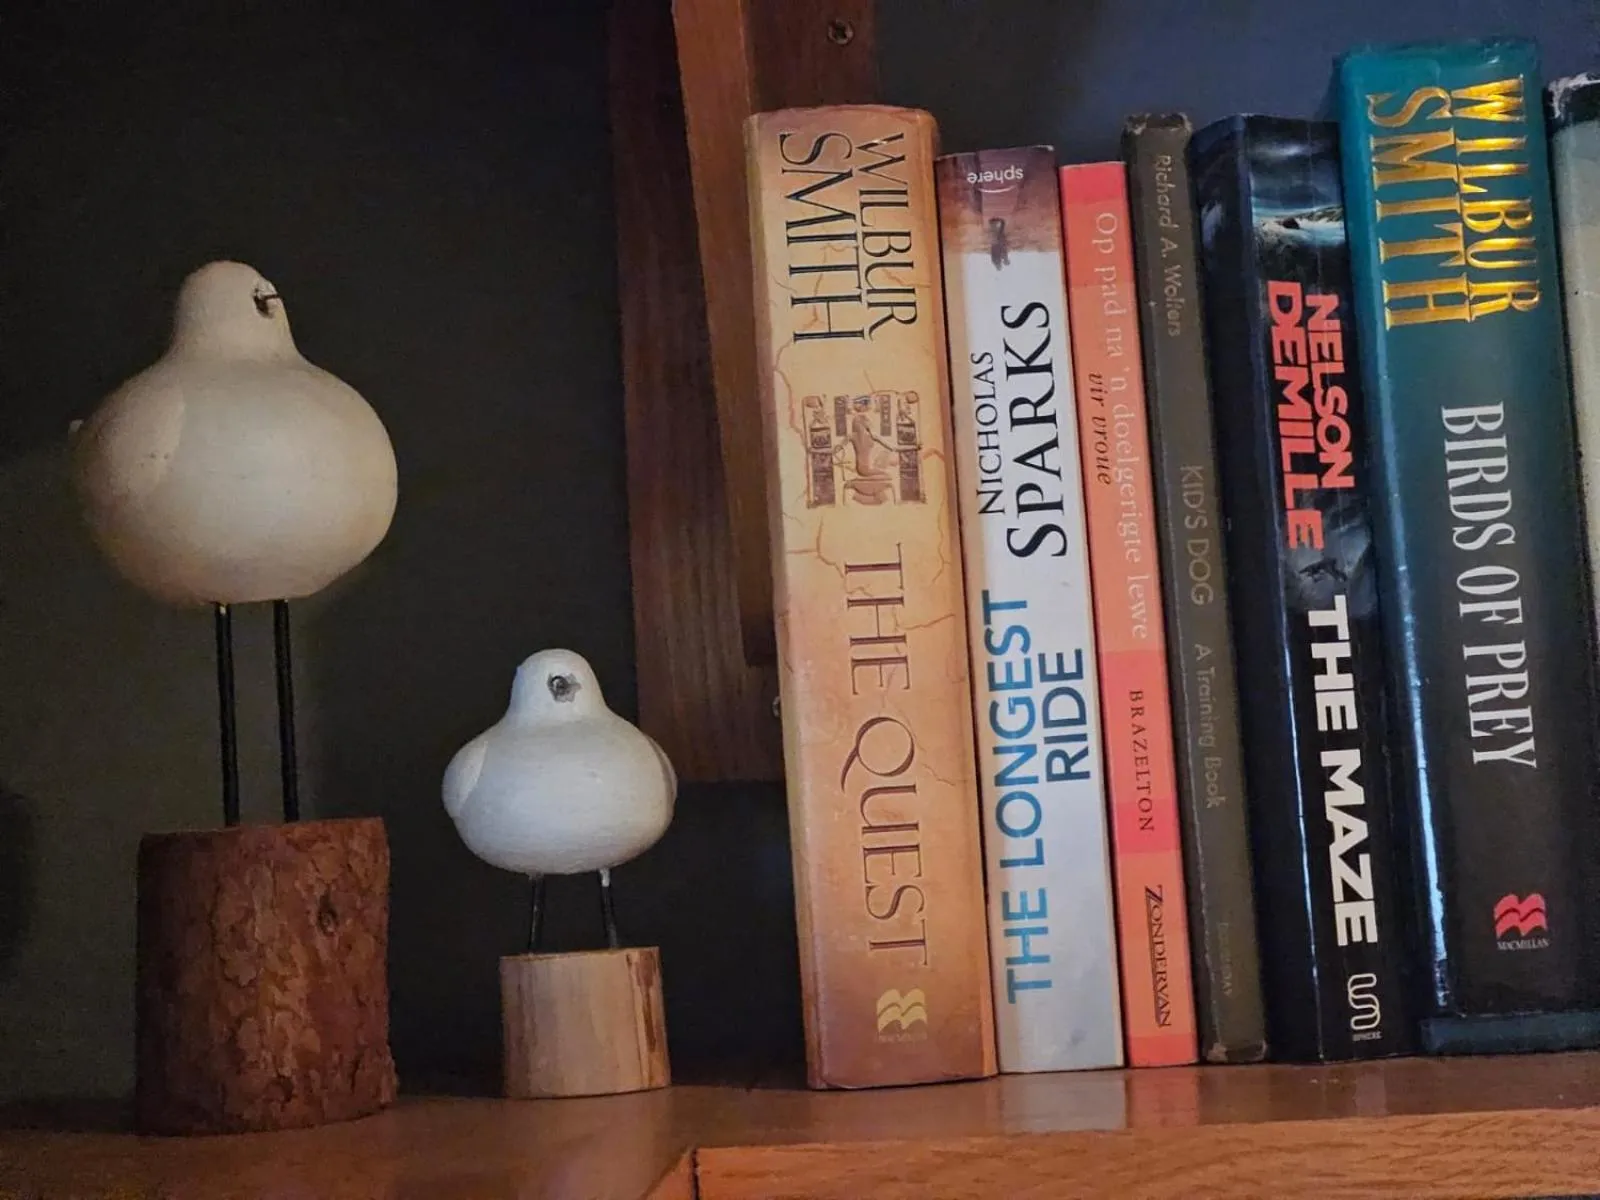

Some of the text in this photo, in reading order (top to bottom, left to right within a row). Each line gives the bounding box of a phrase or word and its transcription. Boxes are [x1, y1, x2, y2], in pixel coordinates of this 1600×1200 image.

[779, 132, 865, 344] SMITH
[856, 132, 918, 341] WILBUR
[967, 165, 1024, 184] sphere
[1092, 212, 1118, 254] Op
[1156, 154, 1179, 229] Richard
[1160, 237, 1178, 258] A.
[1366, 87, 1472, 331] SMITH
[1451, 75, 1542, 322] WILBUR
[1094, 263, 1126, 317] pad
[1106, 328, 1124, 358] na
[970, 351, 1005, 515] NICHOLAS
[1001, 301, 1068, 558] SPARKS
[1088, 371, 1112, 485] vir vroue
[1267, 280, 1325, 551] DEMILLE
[1305, 294, 1355, 489] NELSON
[1111, 403, 1143, 564] doelgerigte
[1181, 465, 1214, 605] KID'S DOG
[845, 542, 910, 695] THE
[1126, 575, 1149, 639] lewe
[1441, 401, 1537, 769] BIRDS OF PREY
[1038, 648, 1090, 782] RIDE
[1129, 690, 1155, 831] BRAZELTON
[1195, 643, 1226, 808] A Training Book
[1308, 594, 1378, 946] THE MAZE
[840, 716, 928, 966] QUEST
[982, 589, 1052, 1004] THE LONGEST
[1144, 884, 1172, 1028] ZONDERVAN
